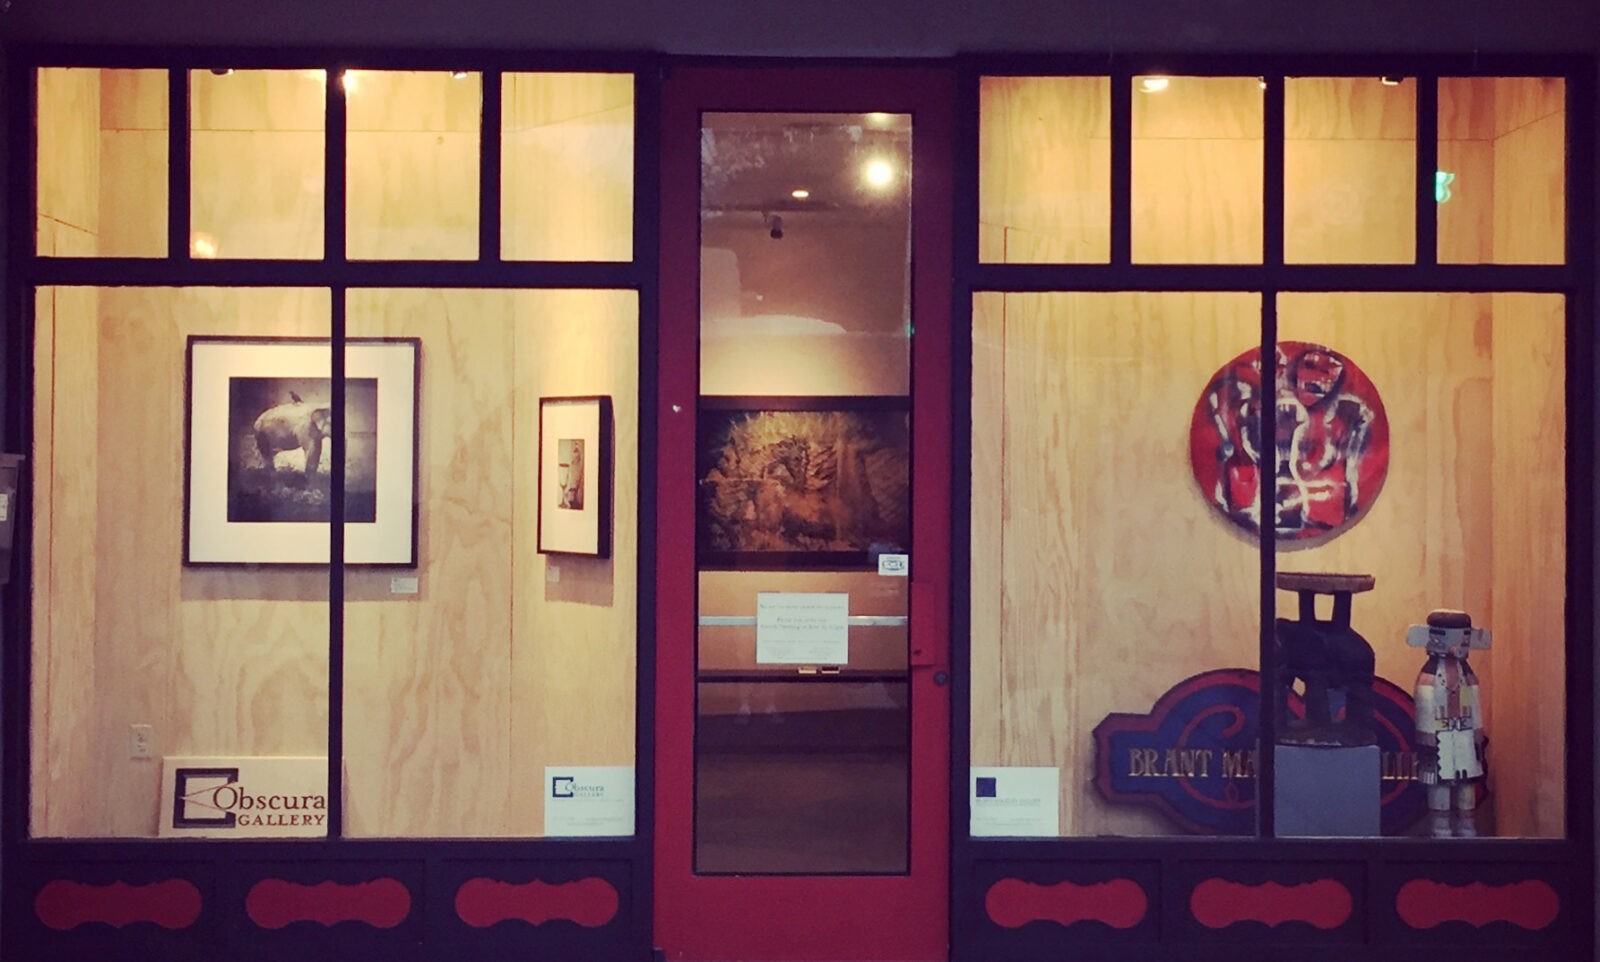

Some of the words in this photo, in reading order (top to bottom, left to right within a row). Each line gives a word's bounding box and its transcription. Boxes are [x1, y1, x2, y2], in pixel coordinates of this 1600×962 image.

[1128, 747, 1213, 778] BRANT
[213, 786, 325, 810] Obscura
[238, 814, 326, 826] GALLERY
